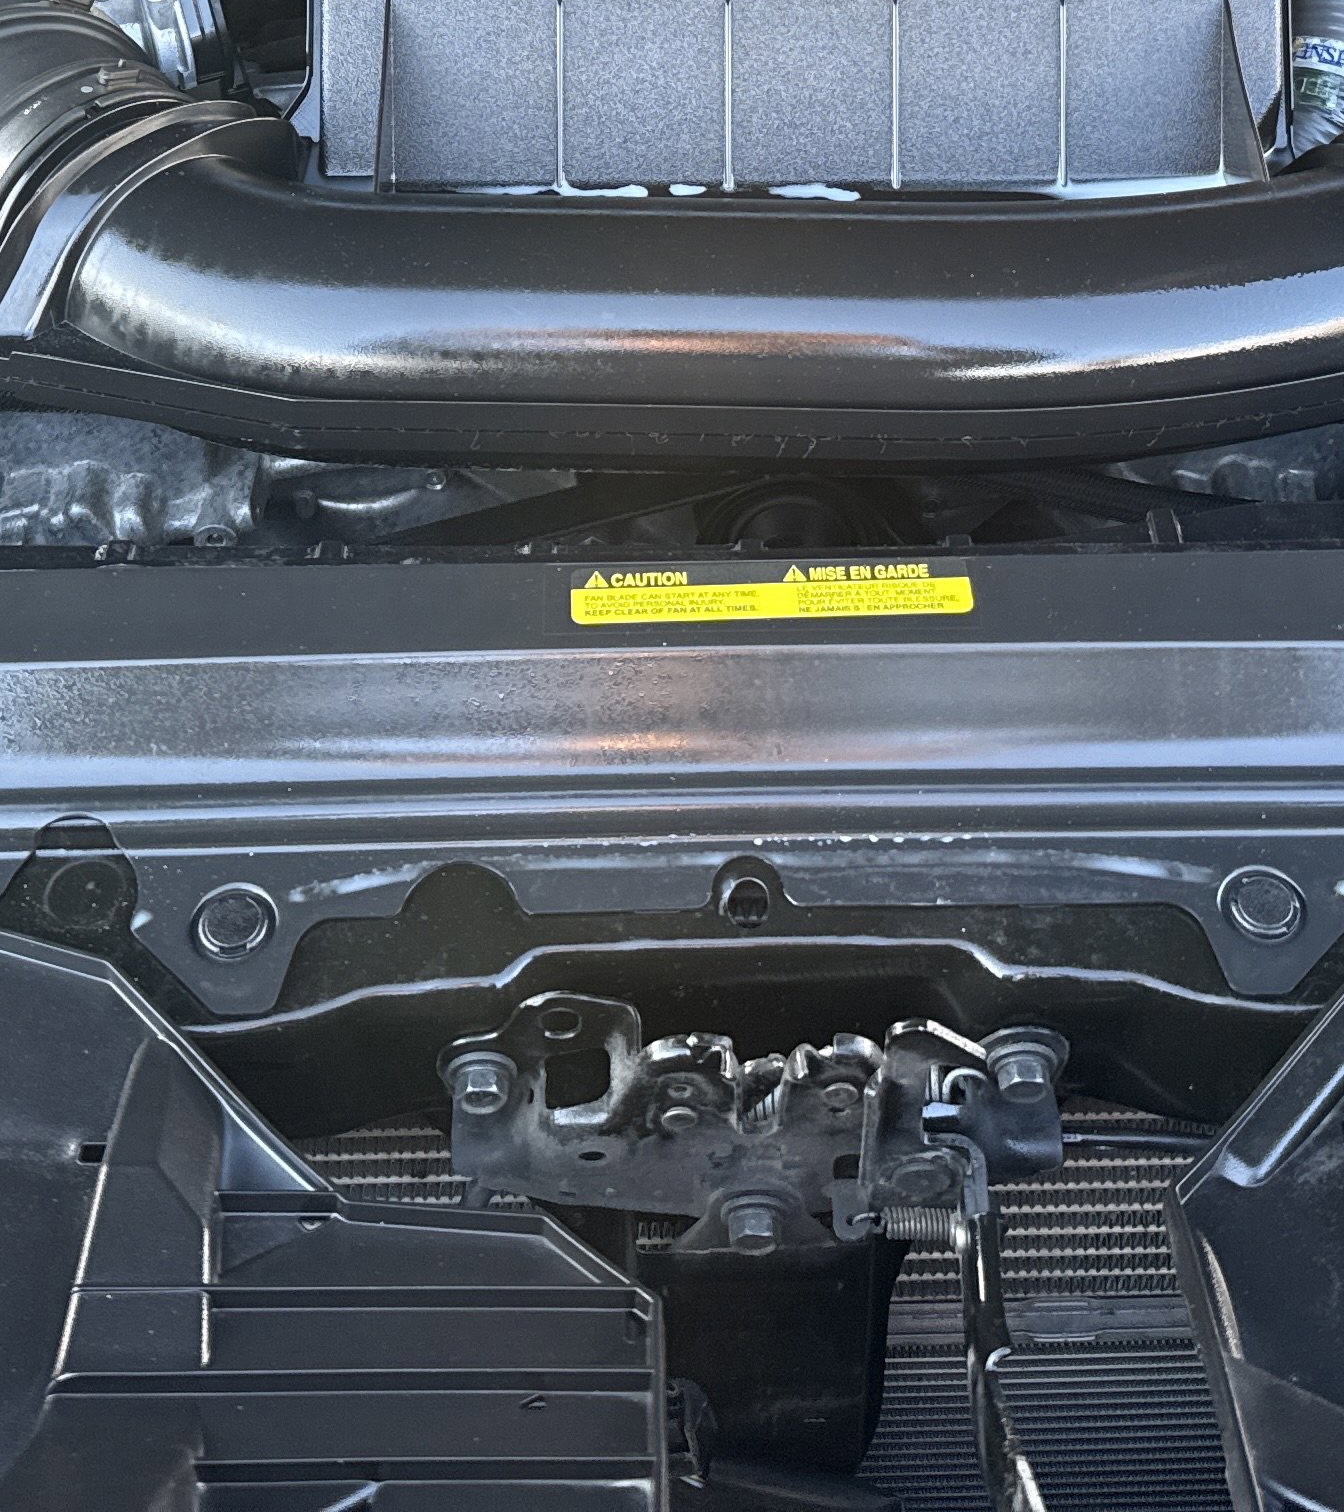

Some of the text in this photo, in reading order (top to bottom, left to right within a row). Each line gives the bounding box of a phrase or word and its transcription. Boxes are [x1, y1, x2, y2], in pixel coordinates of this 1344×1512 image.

[610, 571, 688, 587] CAUTION
[809, 564, 930, 581] MISE EN GARDE
[607, 593, 638, 601] BLADE
[584, 609, 612, 617] KEEP
[614, 608, 648, 616] CLEAR
[667, 606, 687, 614] FAN
